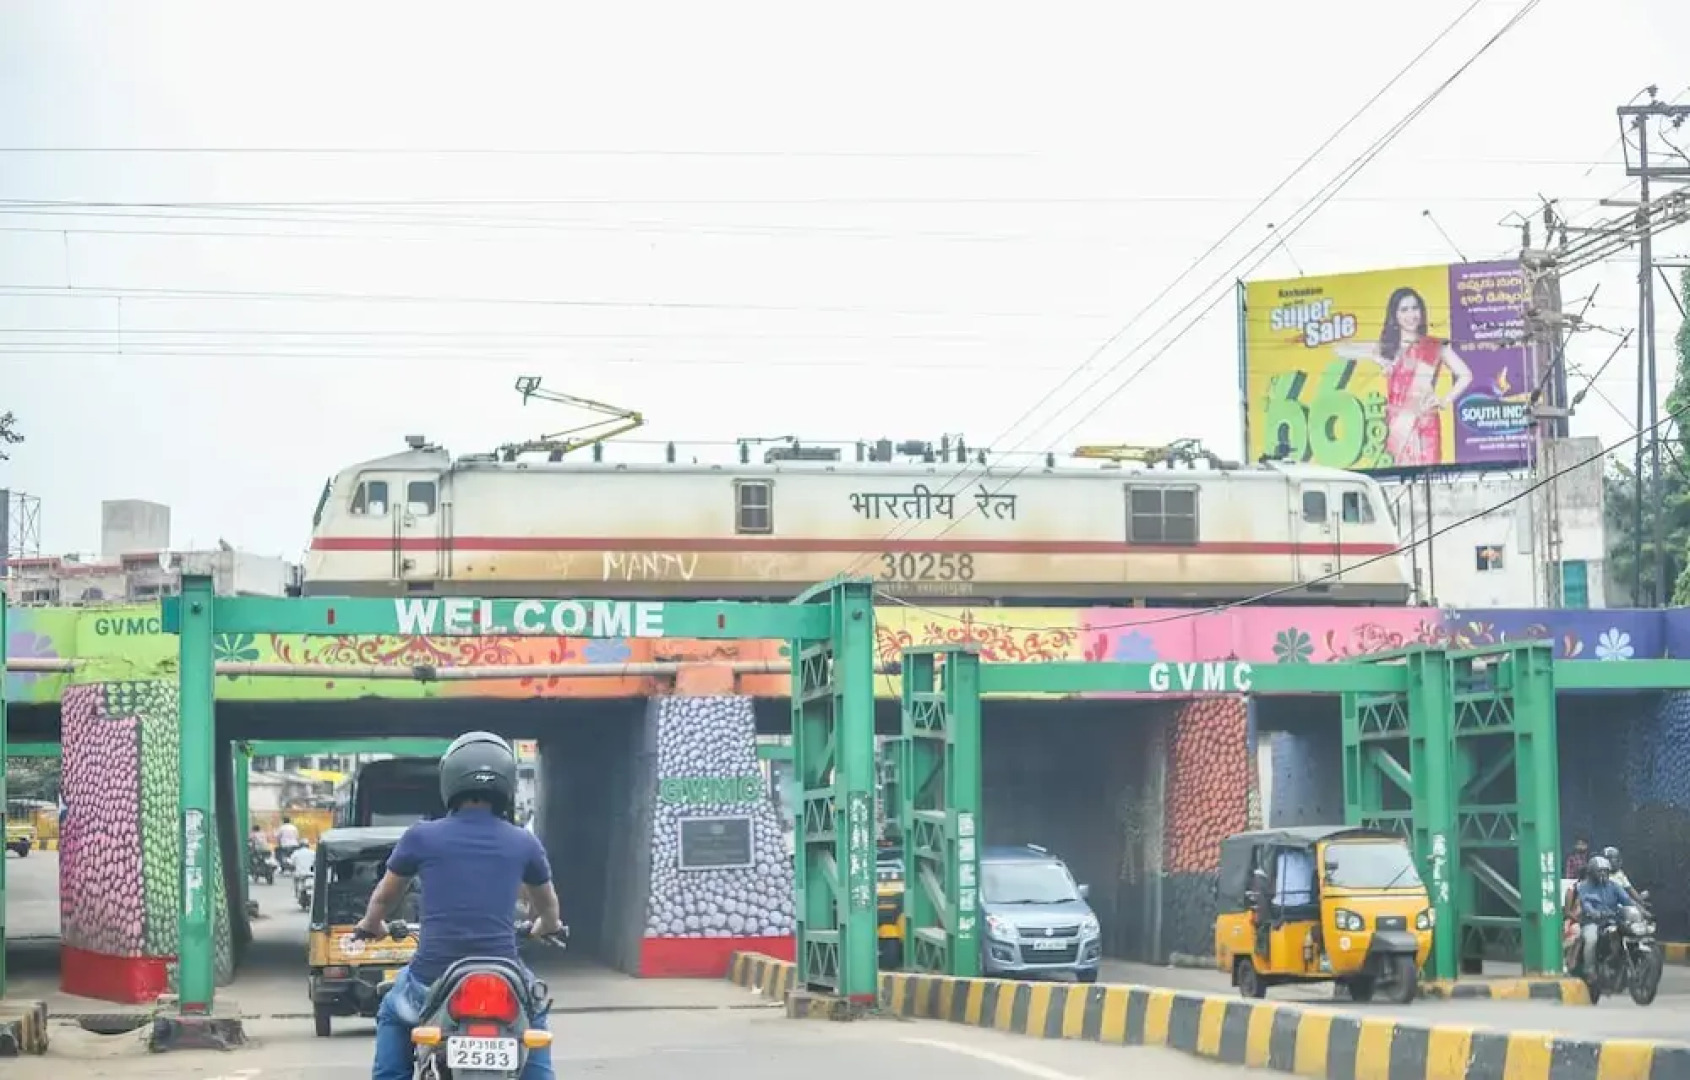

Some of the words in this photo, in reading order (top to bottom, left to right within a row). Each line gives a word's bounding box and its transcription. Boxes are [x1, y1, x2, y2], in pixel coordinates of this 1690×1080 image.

[1461, 406, 1501, 421] SOUTH
[1501, 405, 1528, 419] IND
[849, 484, 956, 520] भारतीय
[973, 484, 1018, 521] रेल
[880, 551, 975, 581] 30258
[95, 616, 161, 636] GVMC
[394, 597, 665, 637] WELCOME
[1148, 660, 1253, 692] GVMC
[660, 776, 761, 804] GVMC
[457, 1050, 510, 1067] 2583
